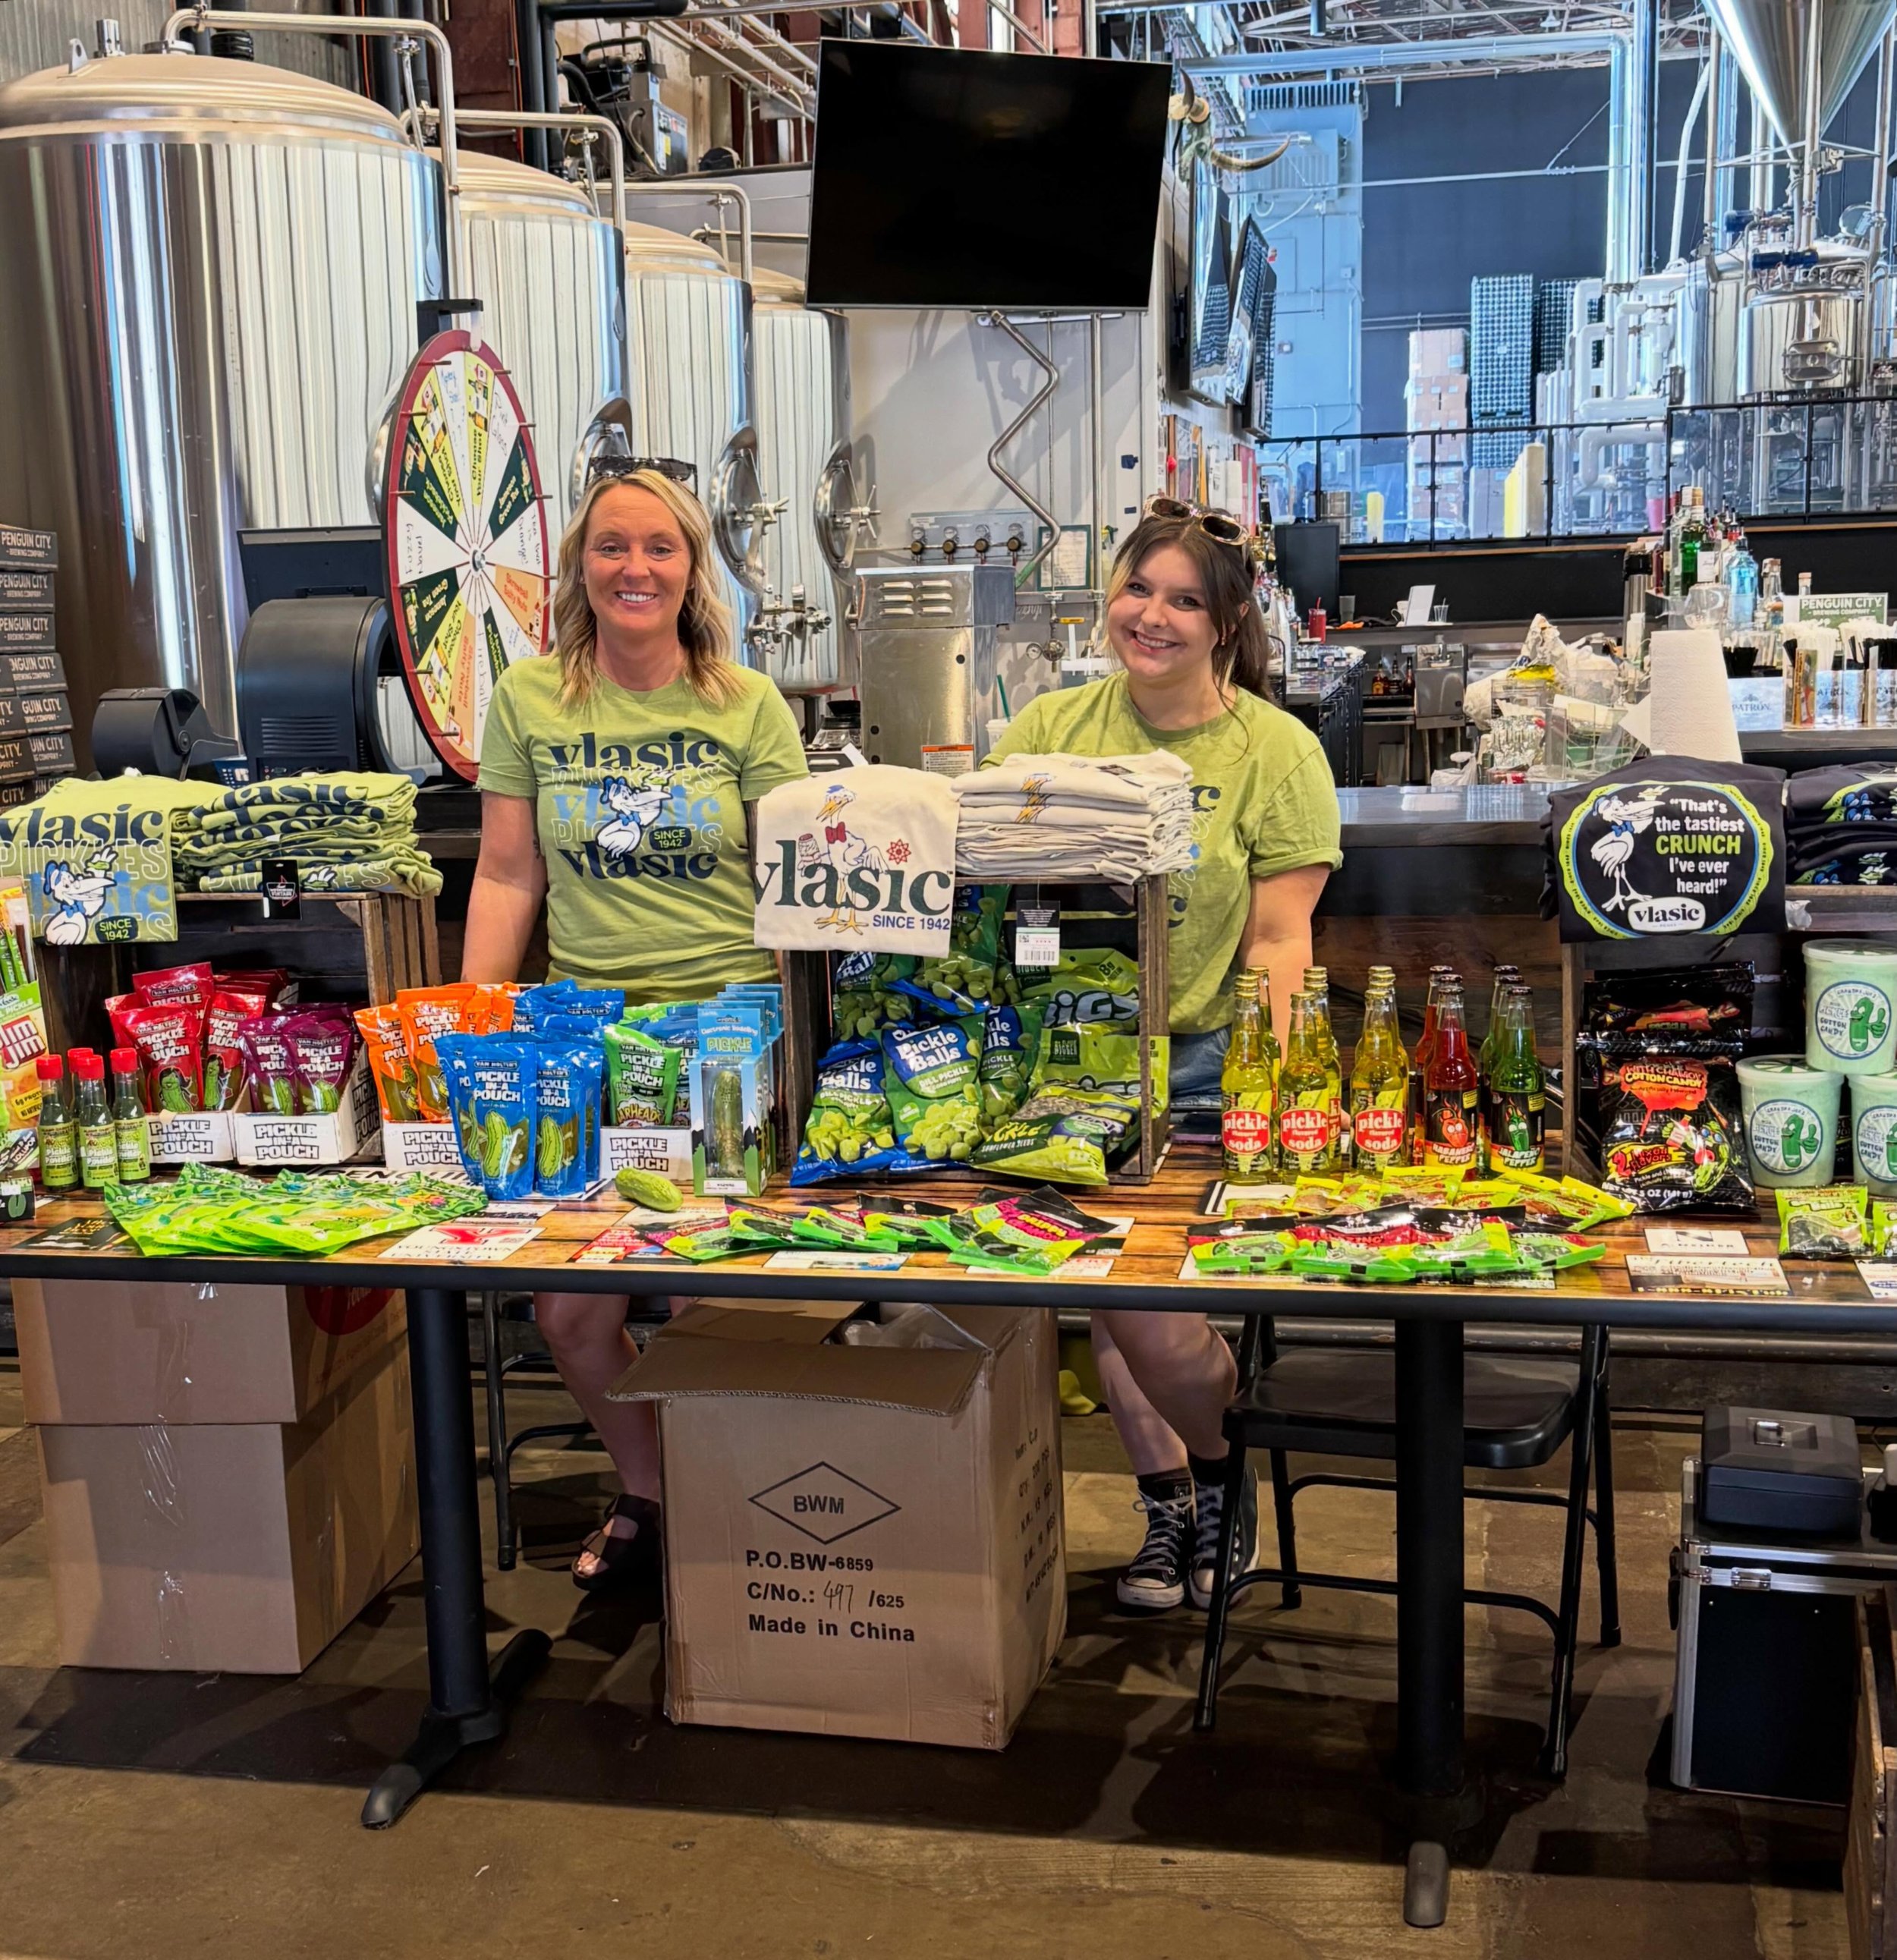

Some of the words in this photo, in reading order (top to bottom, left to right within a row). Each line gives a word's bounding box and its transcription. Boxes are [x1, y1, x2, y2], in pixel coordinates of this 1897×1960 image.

[2, 532, 34, 547] PENGUIN
[1801, 598, 1854, 610] PENGUIN
[547, 731, 721, 769] vlasic
[1655, 816, 1680, 832] the
[1684, 816, 1745, 833] tastiest
[654, 829, 686, 840] SINCE
[658, 838, 683, 848] 1942
[1656, 835, 1741, 854] CRUNCH
[556, 841, 719, 879] vlasic
[1697, 860, 1729, 873] ever
[1634, 901, 1700, 924] vlasic
[99, 918, 132, 932] SINCE
[873, 915, 915, 929] SINCE
[920, 918, 950, 930] 1942
[105, 930, 131, 940] 1942
[842, 951, 876, 980] Ball
[513, 1024, 534, 1033] PIC
[1820, 1018, 1847, 1030] COTTON
[137, 1027, 187, 1046] PICKLE
[1820, 1027, 1843, 1037] CANDY
[297, 1045, 343, 1056] PICKLE
[706, 1037, 753, 1052] PICKLE
[895, 1030, 958, 1060] Pickle
[384, 1049, 408, 1061] POU
[620, 1053, 665, 1069] PICKLE
[911, 1046, 961, 1072] Balls
[260, 1061, 285, 1071] POU
[299, 1060, 344, 1072] POUCH
[474, 1071, 520, 1083] PICKLE
[622, 1070, 663, 1087] POUCH
[919, 1077, 938, 1088] DILL
[938, 1065, 971, 1081] PICKLE
[1625, 1072, 1666, 1084] COTTON
[1666, 1074, 1703, 1088] CANDY
[24, 1091, 42, 1102] PROT
[473, 1089, 521, 1103] POUCH
[149, 1120, 210, 1135] PICKLE
[355, 1110, 381, 1136] POUC
[1225, 1114, 1268, 1132] pickle
[1282, 1113, 1327, 1131] pickle
[1358, 1113, 1402, 1131] pickle
[254, 1123, 317, 1138] PICKLE
[403, 1131, 458, 1145] PICKL
[610, 1137, 668, 1152] PICKLE
[1228, 1138, 1261, 1151] soda
[1288, 1137, 1322, 1150] soda
[1365, 1137, 1397, 1150] soda
[1754, 1135, 1779, 1146] COTTON
[151, 1140, 213, 1156] POUCH
[256, 1145, 319, 1159] POUCH
[1755, 1144, 1776, 1153] CANDY
[1860, 1141, 1884, 1153] COTTON
[1861, 1149, 1881, 1159] CANDY
[611, 1157, 669, 1172] POUCH
[1439, 1153, 1471, 1164] PEPPER
[1504, 1157, 1536, 1168] PEPPER
[1647, 1189, 1661, 1197] OZ
[794, 1495, 845, 1514] BWM
[747, 1581, 815, 1603] C/No.:
[868, 1590, 904, 1608] /625
[749, 1614, 806, 1634] Made
[818, 1619, 838, 1636] in
[849, 1622, 915, 1642] China
